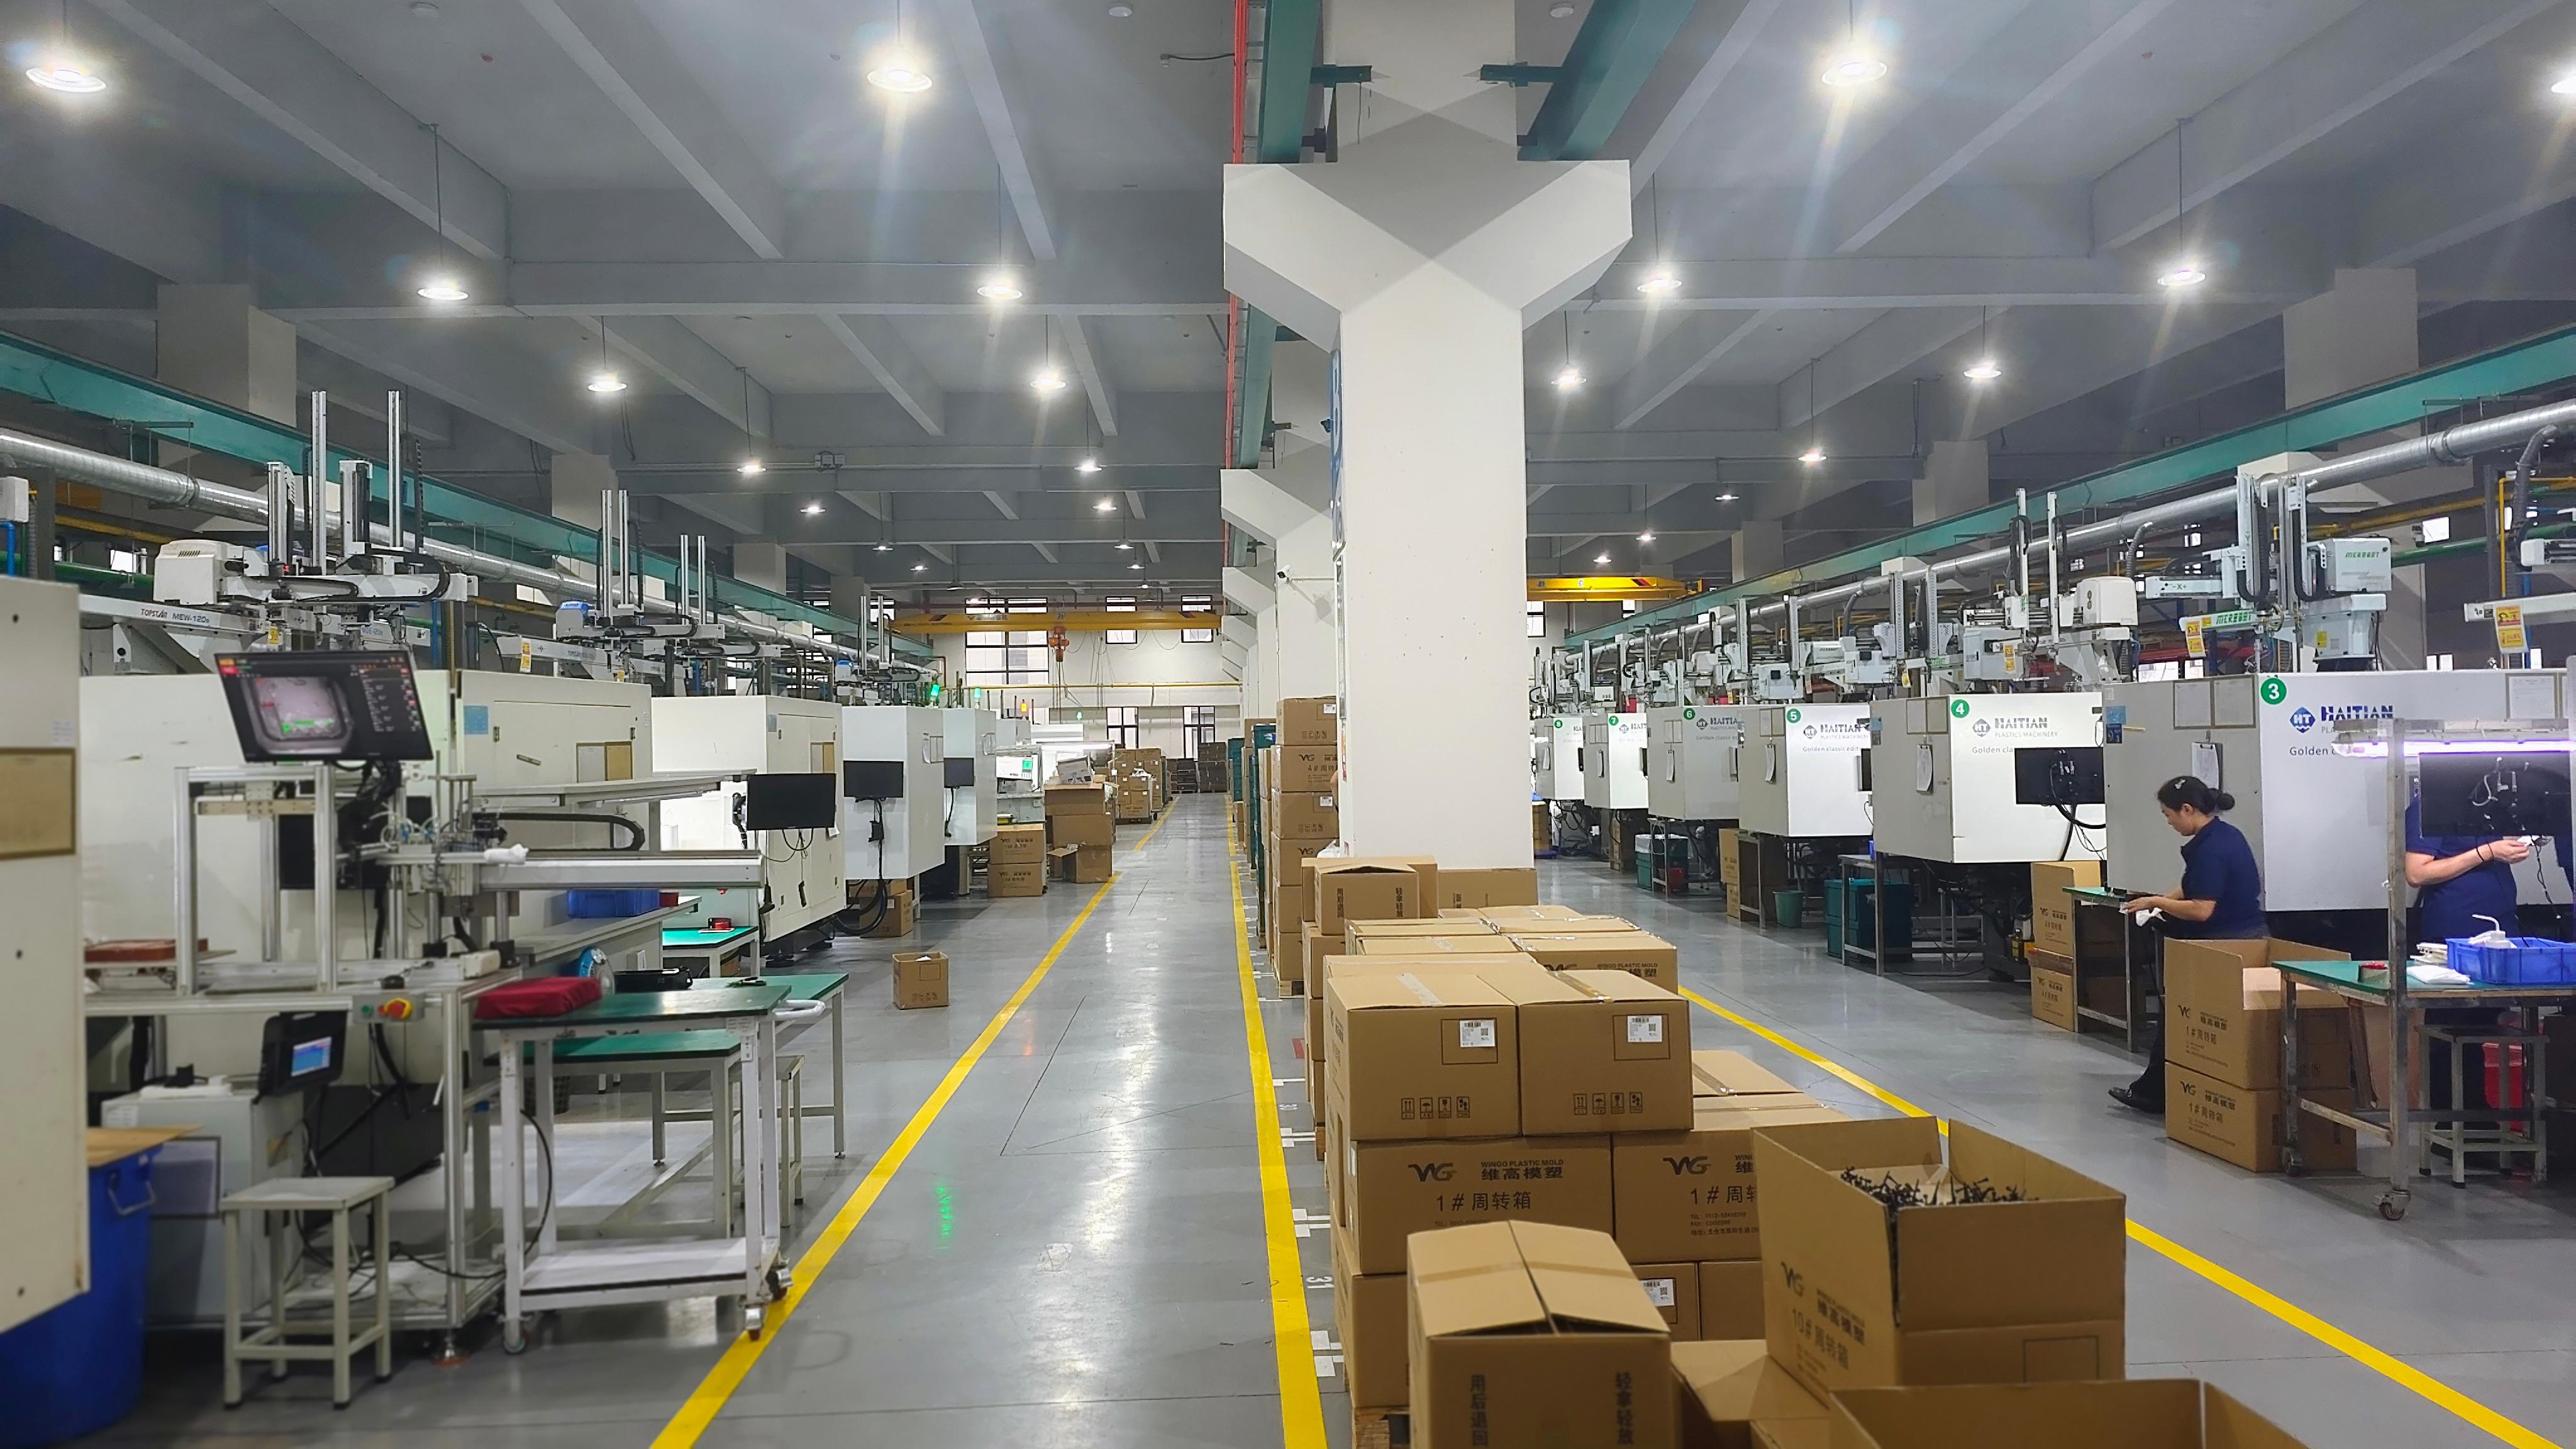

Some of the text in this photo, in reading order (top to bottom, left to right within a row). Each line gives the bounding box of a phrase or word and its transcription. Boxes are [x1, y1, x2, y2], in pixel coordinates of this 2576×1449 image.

[2268, 682, 2280, 700] 3
[1686, 710, 1692, 719] 6
[1955, 702, 1965, 715] 4
[2321, 705, 2394, 721] HAITIAN
[1790, 711, 1797, 721] 5
[1820, 724, 1861, 733] HAITIAN
[1995, 718, 2048, 729] HAITIAN
[2290, 747, 2328, 755] Golden
[1481, 1166, 1564, 1182] 维高模塑
[1736, 1161, 1754, 1174] 维
[1306, 1276, 1335, 1289] 31
[1470, 1374, 1489, 1447] 用后退回
[1615, 1372, 1634, 1445] 轻拿轻放
